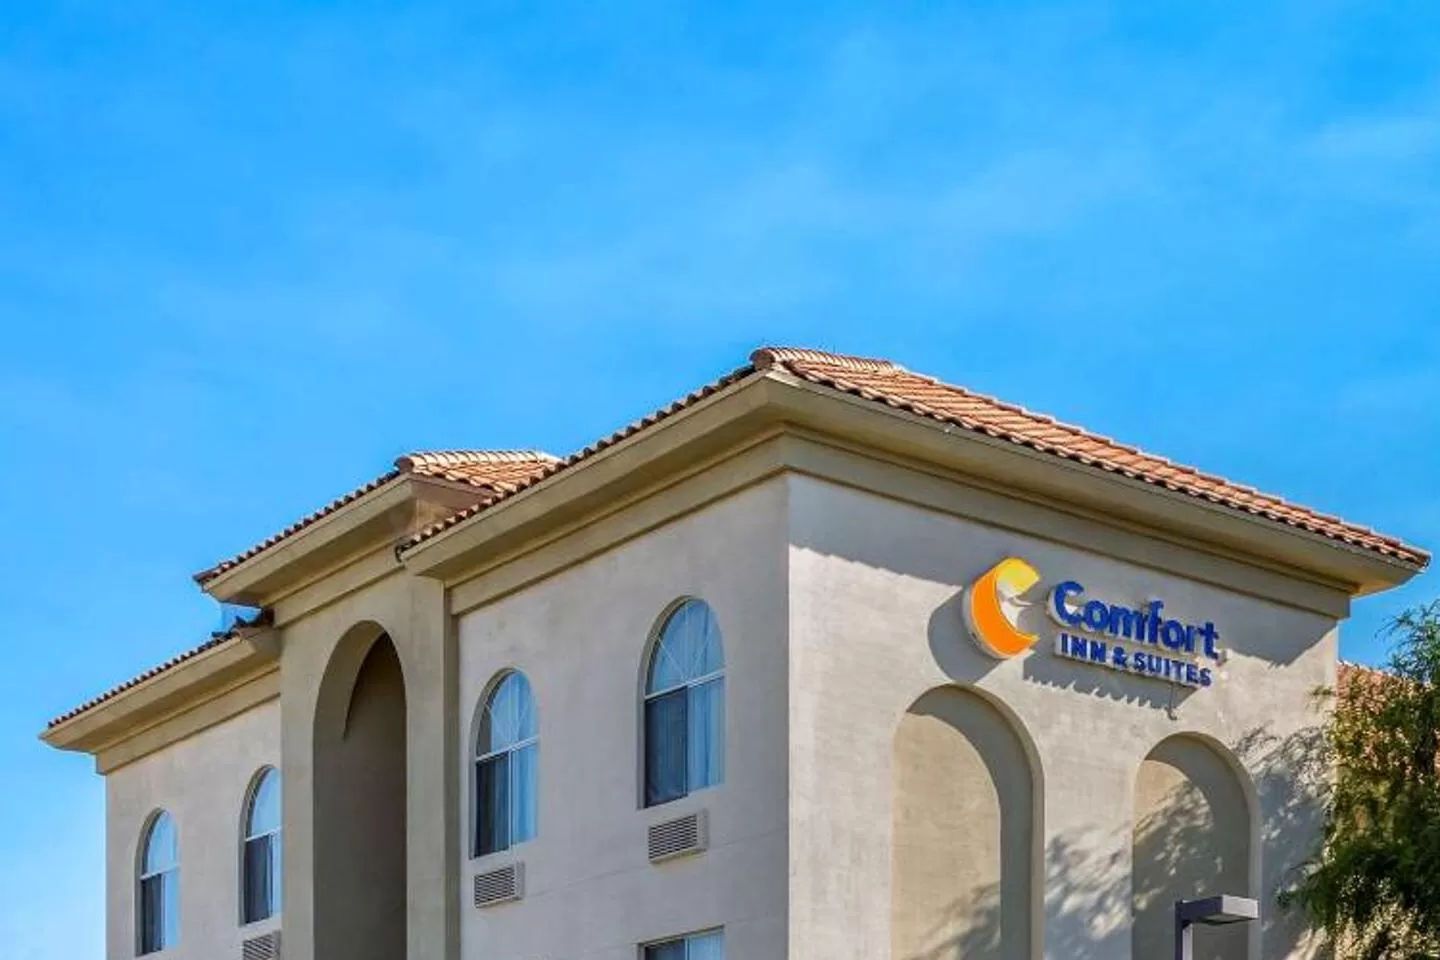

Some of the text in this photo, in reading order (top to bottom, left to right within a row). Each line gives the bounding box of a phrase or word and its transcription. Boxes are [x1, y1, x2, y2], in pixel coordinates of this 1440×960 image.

[1054, 581, 1219, 660] Comfort
[1061, 632, 1213, 687] INN & SUITES
